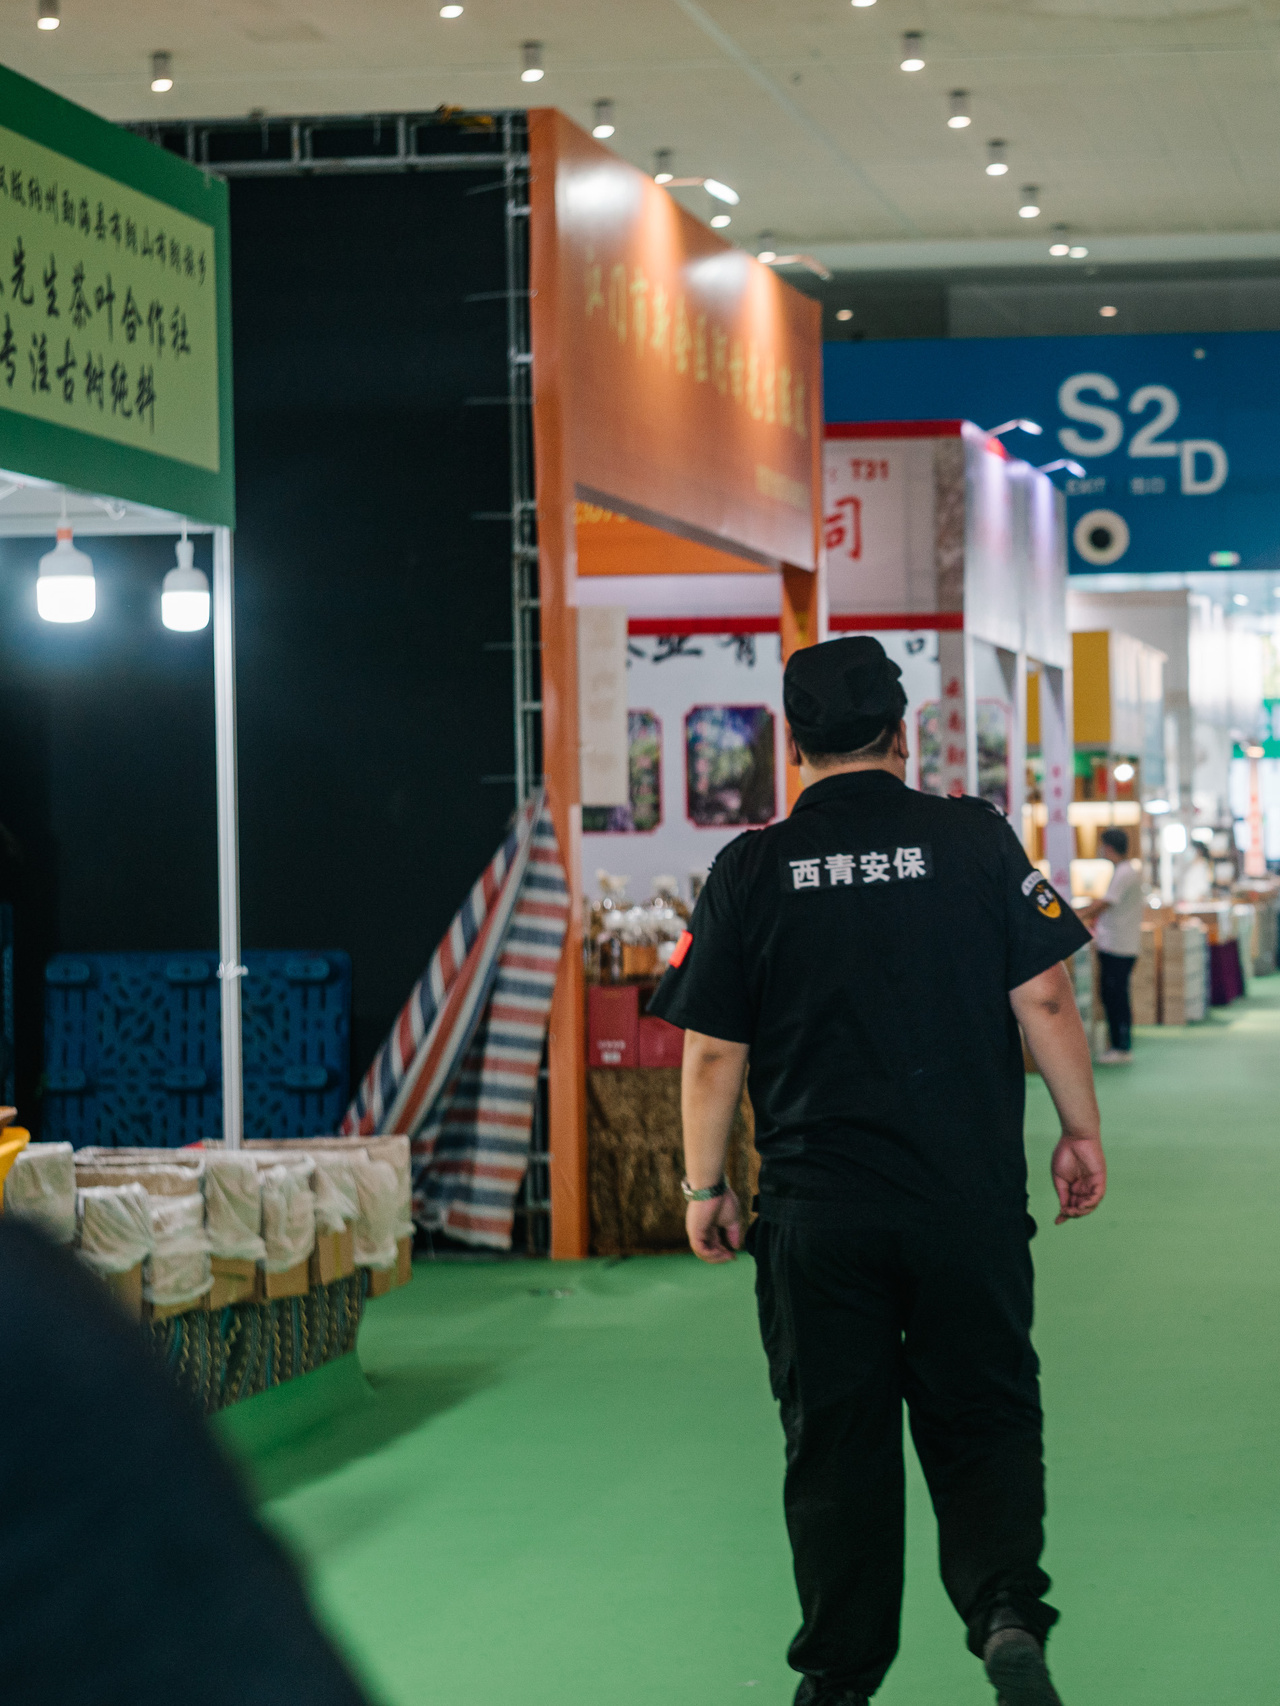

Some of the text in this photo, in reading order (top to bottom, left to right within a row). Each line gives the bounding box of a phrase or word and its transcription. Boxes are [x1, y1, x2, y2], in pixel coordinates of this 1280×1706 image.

[0, 235, 191, 360] 先生茶叶合作社
[789, 847, 926, 889] 西青安保
